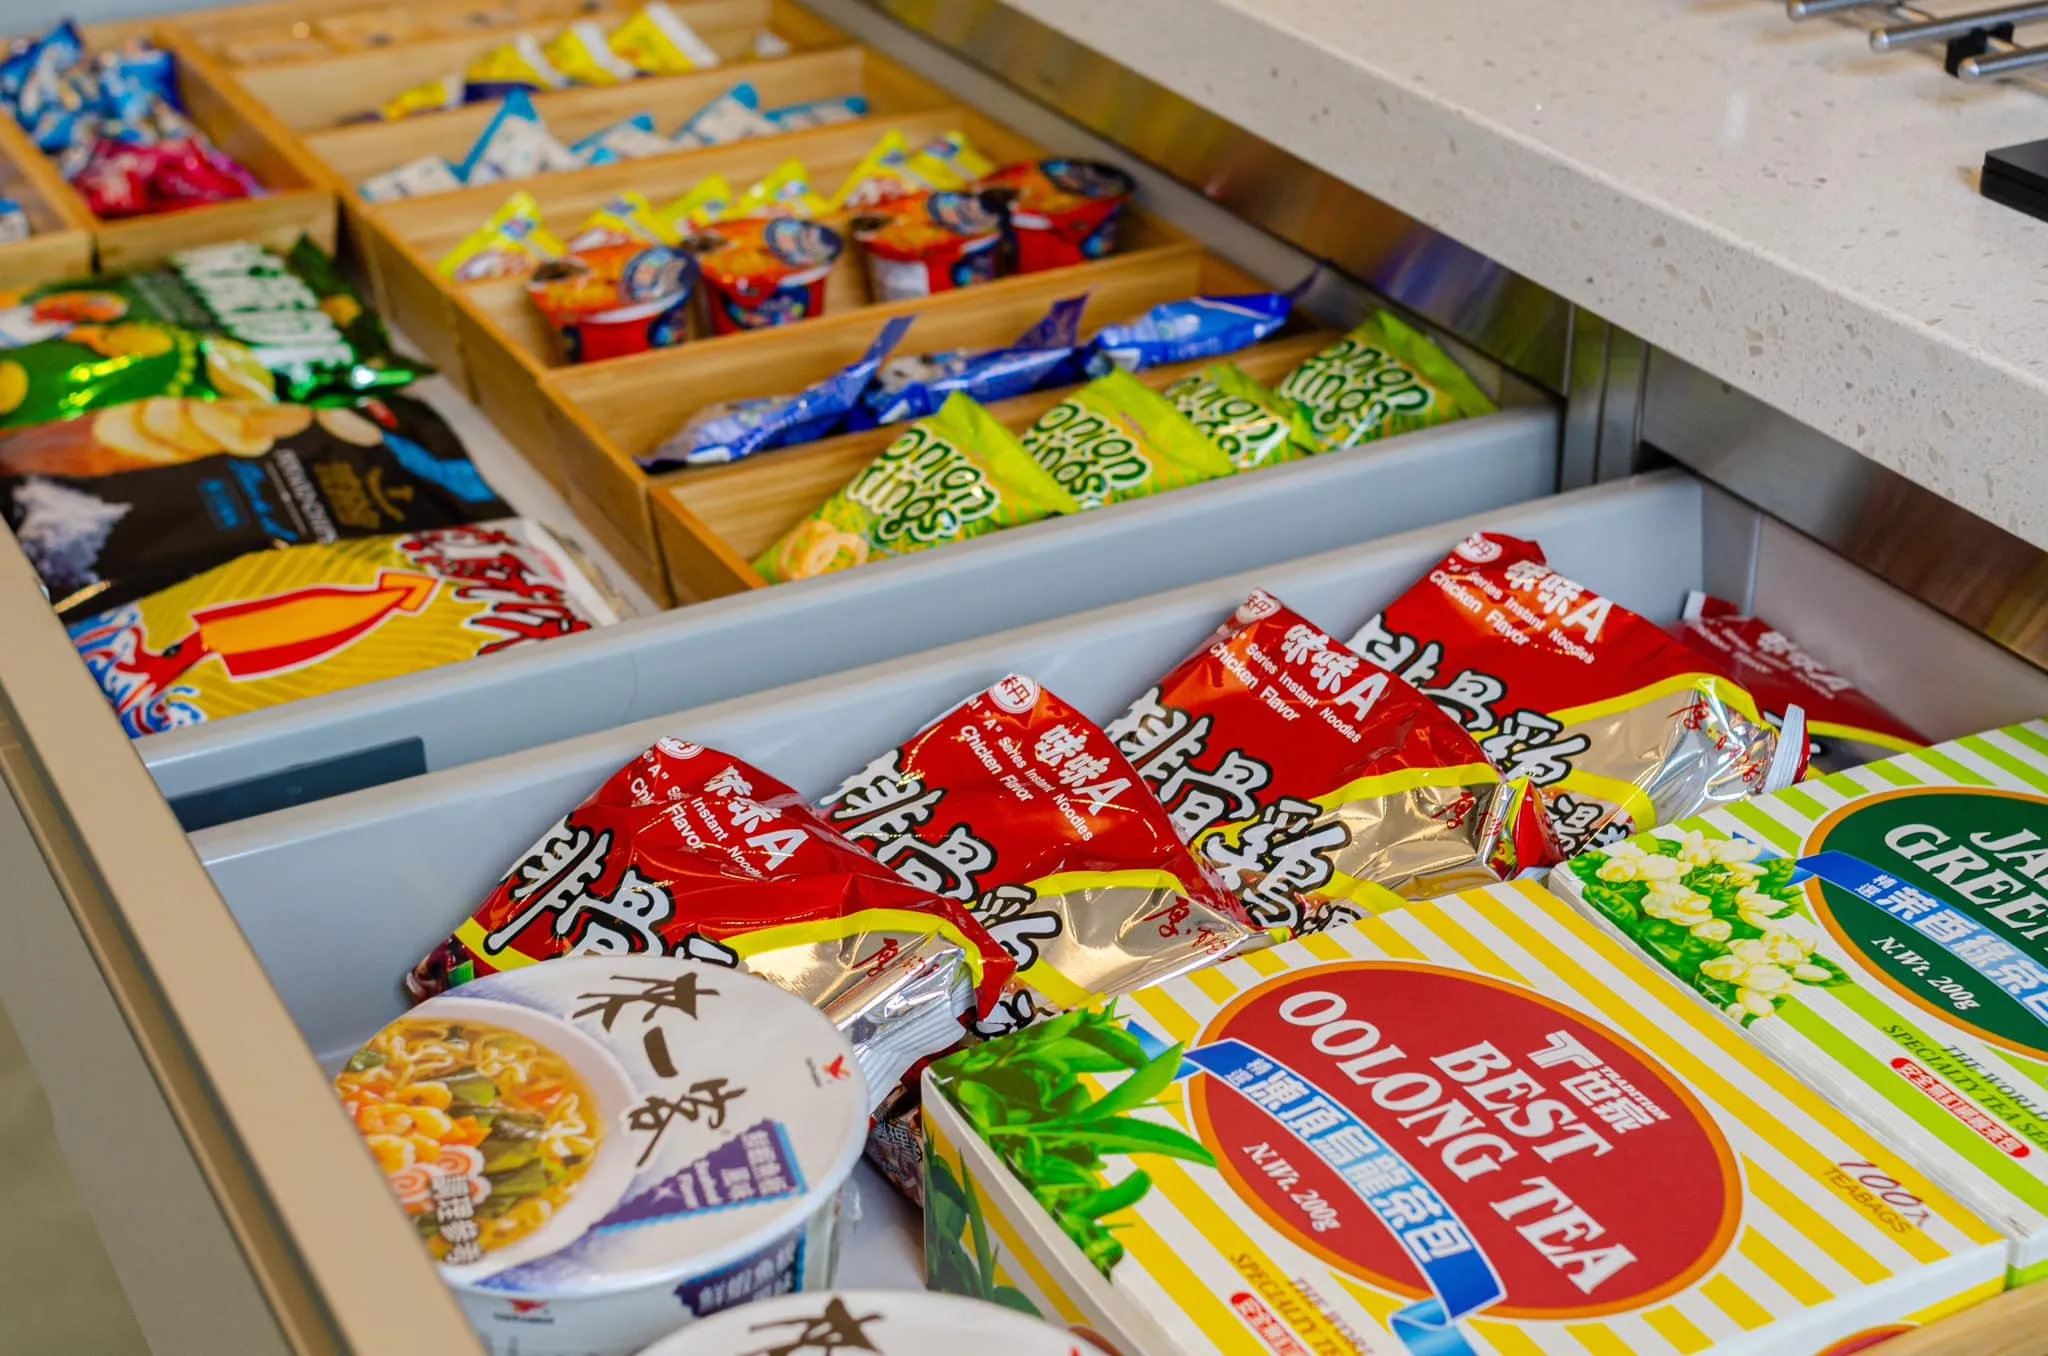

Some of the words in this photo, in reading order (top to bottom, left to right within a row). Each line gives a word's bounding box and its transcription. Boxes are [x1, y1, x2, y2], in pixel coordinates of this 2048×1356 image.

[880, 425, 997, 520] onion
[1034, 402, 1150, 486] onion
[848, 462, 958, 540] rings
[1429, 570, 1484, 615] Chicken
[1484, 609, 1531, 649] Flavor
[1503, 596, 1546, 633] Instant
[1549, 623, 1595, 666] Noodles
[1209, 641, 1260, 691] Chicken
[1259, 685, 1301, 722] Flavor
[1244, 642, 1279, 678] Series
[1278, 667, 1318, 709] Instant
[1317, 706, 1363, 744] Noodles
[1281, 623, 1389, 724] 味味A
[959, 724, 1003, 775] Chicken
[1001, 770, 1036, 804] Flavor
[997, 735, 1029, 770] Series
[1023, 766, 1057, 796] Instant
[1051, 791, 1096, 844] Noodles
[1036, 721, 1132, 818] 味味A
[667, 803, 706, 853] Flavor
[691, 796, 728, 843] Instant
[485, 816, 738, 967] 排骨
[1970, 828, 2048, 893] JA
[1871, 936, 1931, 977] N.Wt.
[1927, 975, 1981, 1011] 200g
[1597, 1064, 1673, 1122] TRADITION
[1882, 1024, 1987, 1093] SPECIALTY
[1980, 1093, 2021, 1122] TEA
[1943, 1043, 1986, 1075] THE
[1431, 1039, 1614, 1166] BEST
[1278, 990, 1518, 1186] OOLONG
[1490, 1175, 1638, 1297] TEA
[1242, 1142, 1293, 1192] N.Wt.
[1289, 1188, 1344, 1234] 200g
[1822, 1165, 1913, 1236] TEABAGS
[1229, 1252, 1317, 1336] SPECIALTY
[1288, 1276, 1330, 1316] THE
